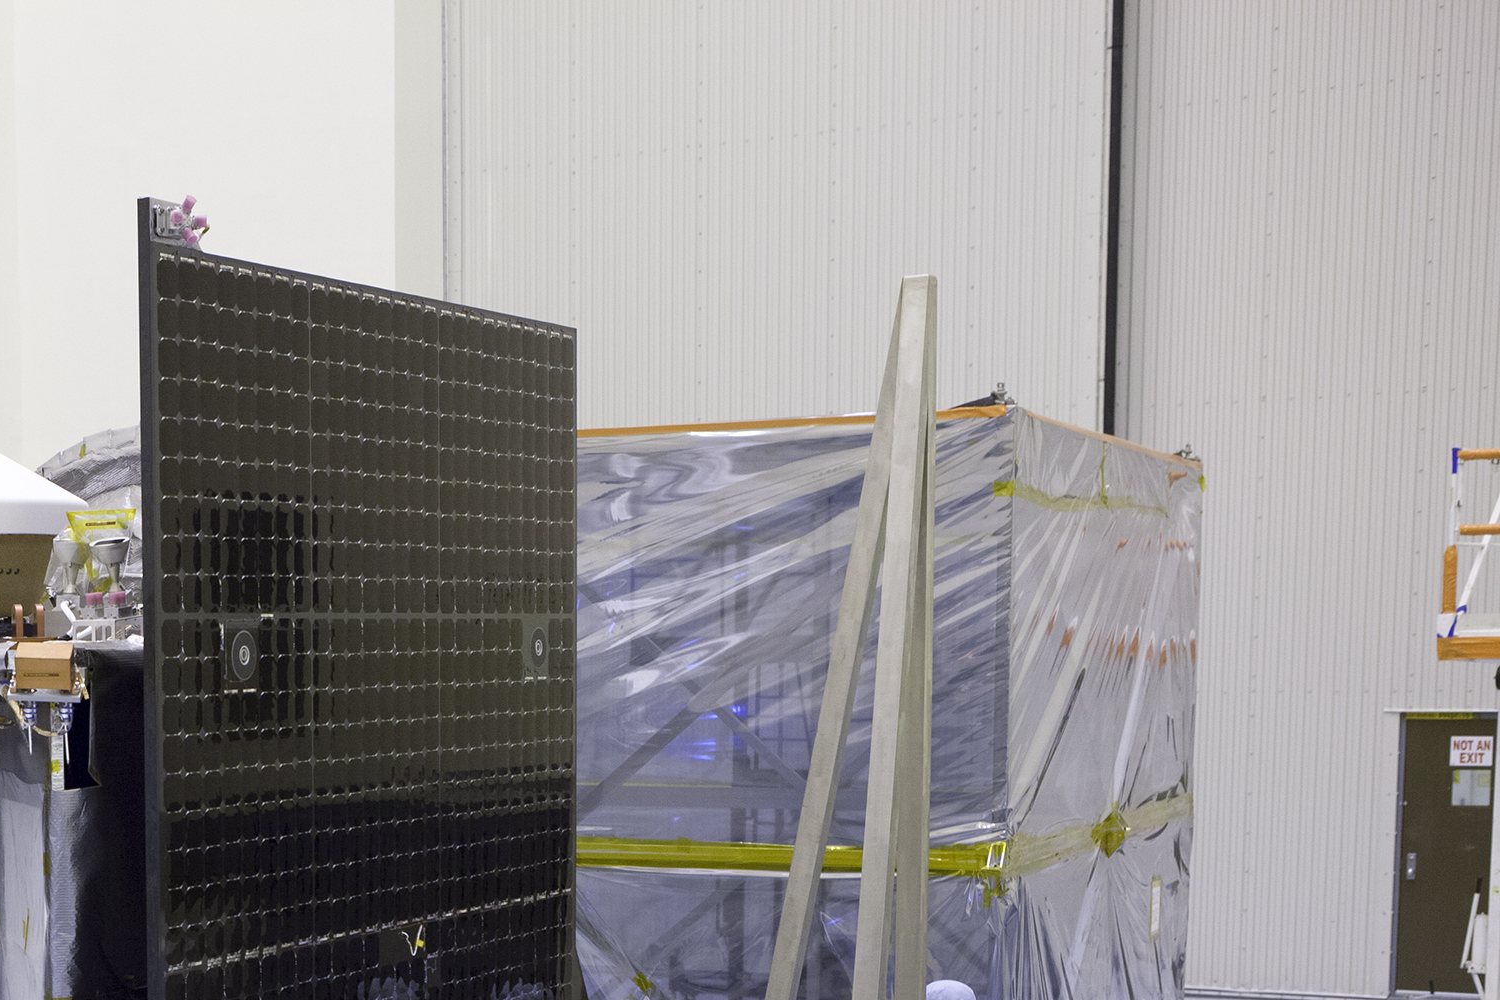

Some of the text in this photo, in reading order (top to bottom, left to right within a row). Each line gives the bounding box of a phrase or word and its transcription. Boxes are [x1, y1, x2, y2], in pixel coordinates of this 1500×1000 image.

[1453, 740, 1491, 751] NOT AN
[1459, 752, 1485, 764] EXIT
